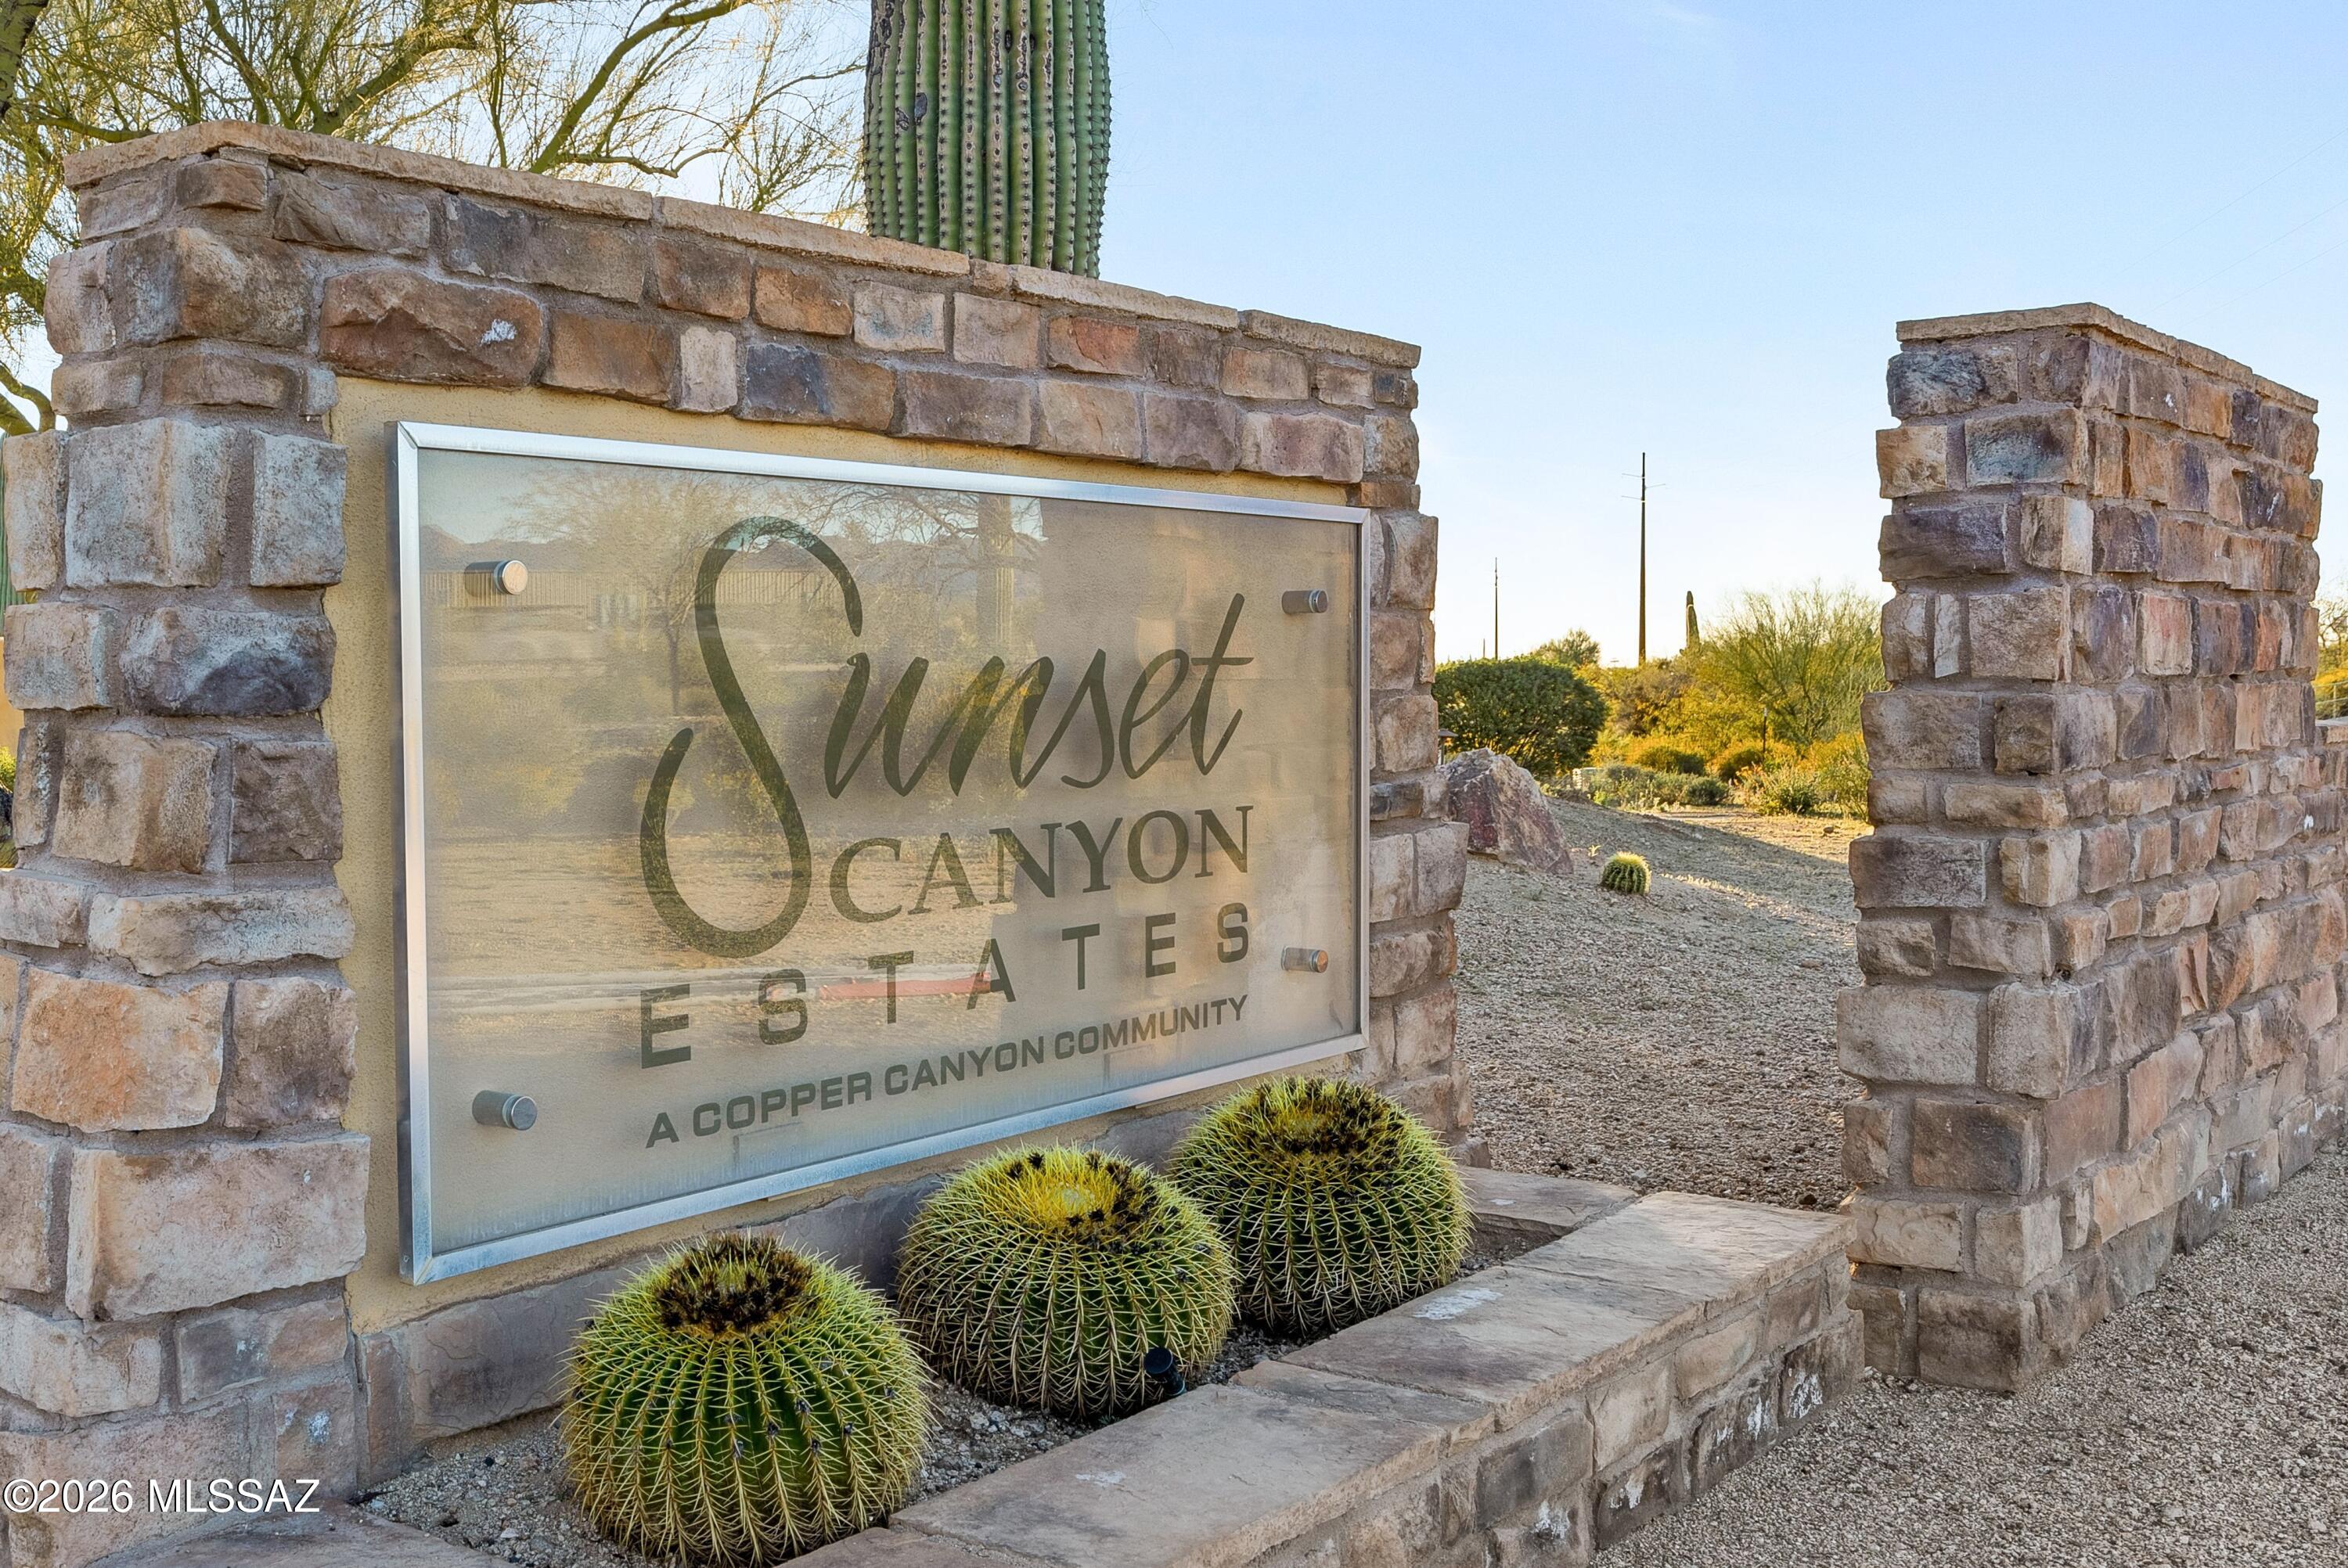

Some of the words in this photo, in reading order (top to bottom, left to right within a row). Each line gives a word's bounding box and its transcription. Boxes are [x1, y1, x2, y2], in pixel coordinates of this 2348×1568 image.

[640, 516, 1254, 958] Sunset
[830, 805, 1253, 922] CANYON
[640, 902, 1249, 1069] ESTATES
[646, 1112, 680, 1149] A
[693, 1071, 873, 1136] COPPER
[884, 1036, 1044, 1091] CANYON
[1054, 994, 1248, 1055] COMMUNITY
